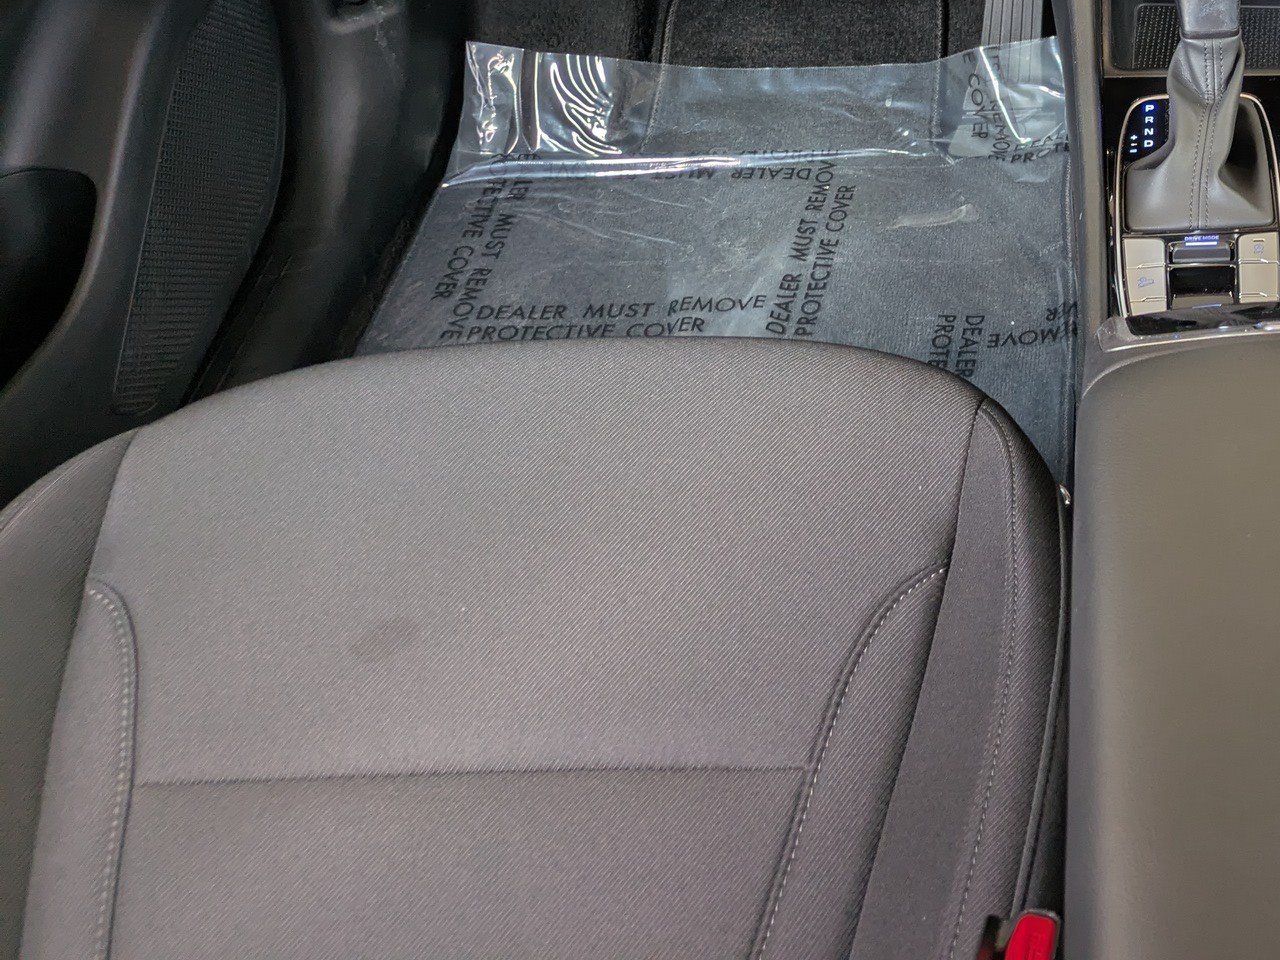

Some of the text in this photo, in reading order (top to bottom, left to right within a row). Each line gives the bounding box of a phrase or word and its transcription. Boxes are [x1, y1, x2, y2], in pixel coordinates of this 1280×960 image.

[968, 73, 989, 139] COVER
[1145, 104, 1155, 112] P
[1144, 116, 1154, 124] R
[1144, 127, 1154, 135] N
[1143, 139, 1154, 147] D
[731, 167, 812, 181] DEALER
[481, 213, 517, 260] MUST
[765, 160, 837, 336] DEALER MUST REMOV
[431, 245, 474, 301] COVER
[794, 184, 857, 337] PROTECTIVE COVER
[440, 267, 493, 340] REMOVE
[476, 294, 767, 321] DEALER MUST REMOVE
[466, 316, 705, 341] PROTECTIVE COVER
